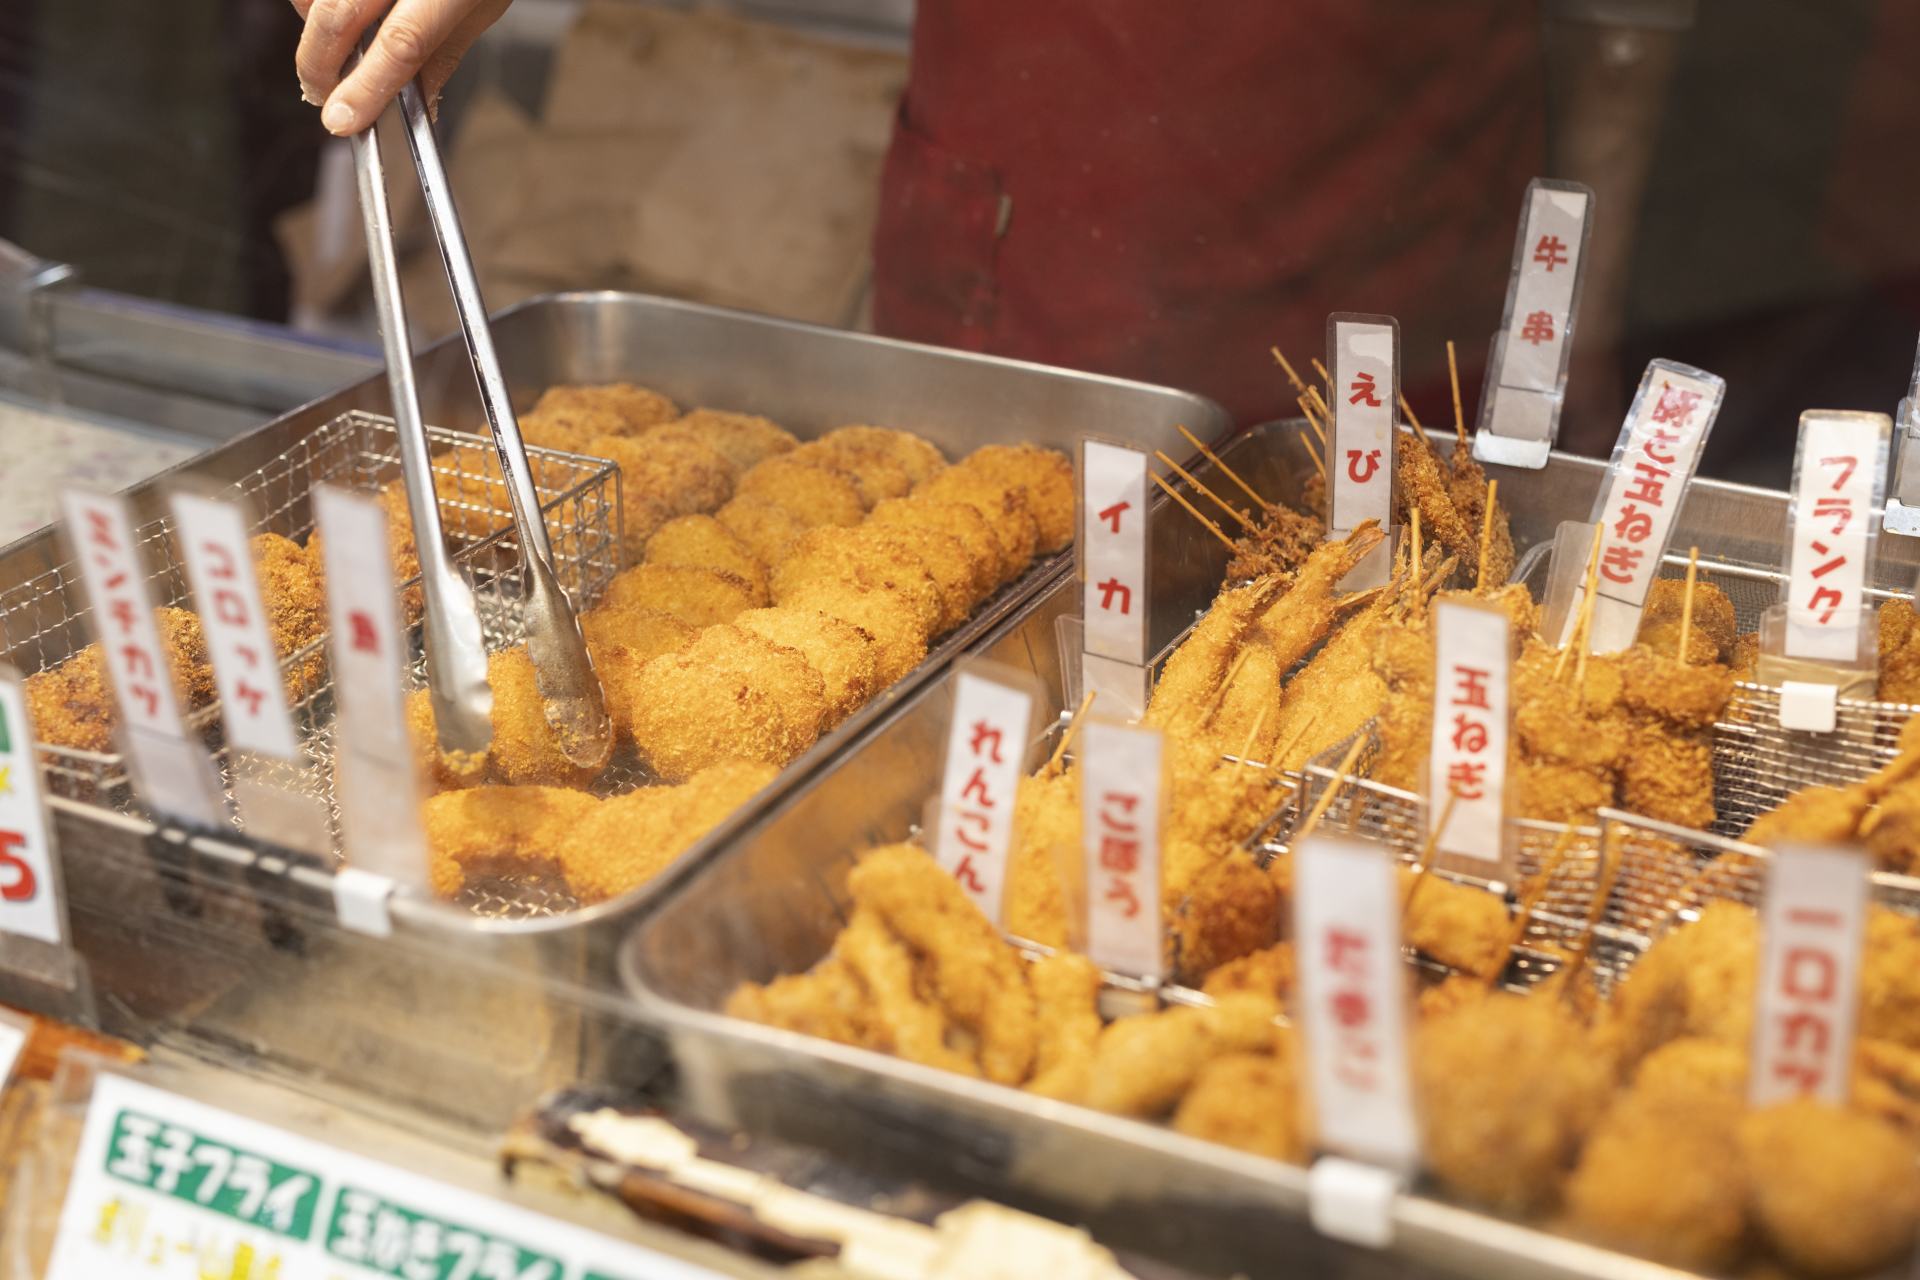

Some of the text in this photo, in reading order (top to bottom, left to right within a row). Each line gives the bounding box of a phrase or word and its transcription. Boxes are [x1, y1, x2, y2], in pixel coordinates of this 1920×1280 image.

[1525, 234, 1569, 346] 牛串
[1346, 371, 1382, 484] えび
[1097, 500, 1132, 615] イカ
[1807, 455, 1858, 625] フランク
[201, 541, 270, 719] コロッケ
[1448, 664, 1492, 801] 玉ねぎ
[953, 719, 1005, 895] れんこん
